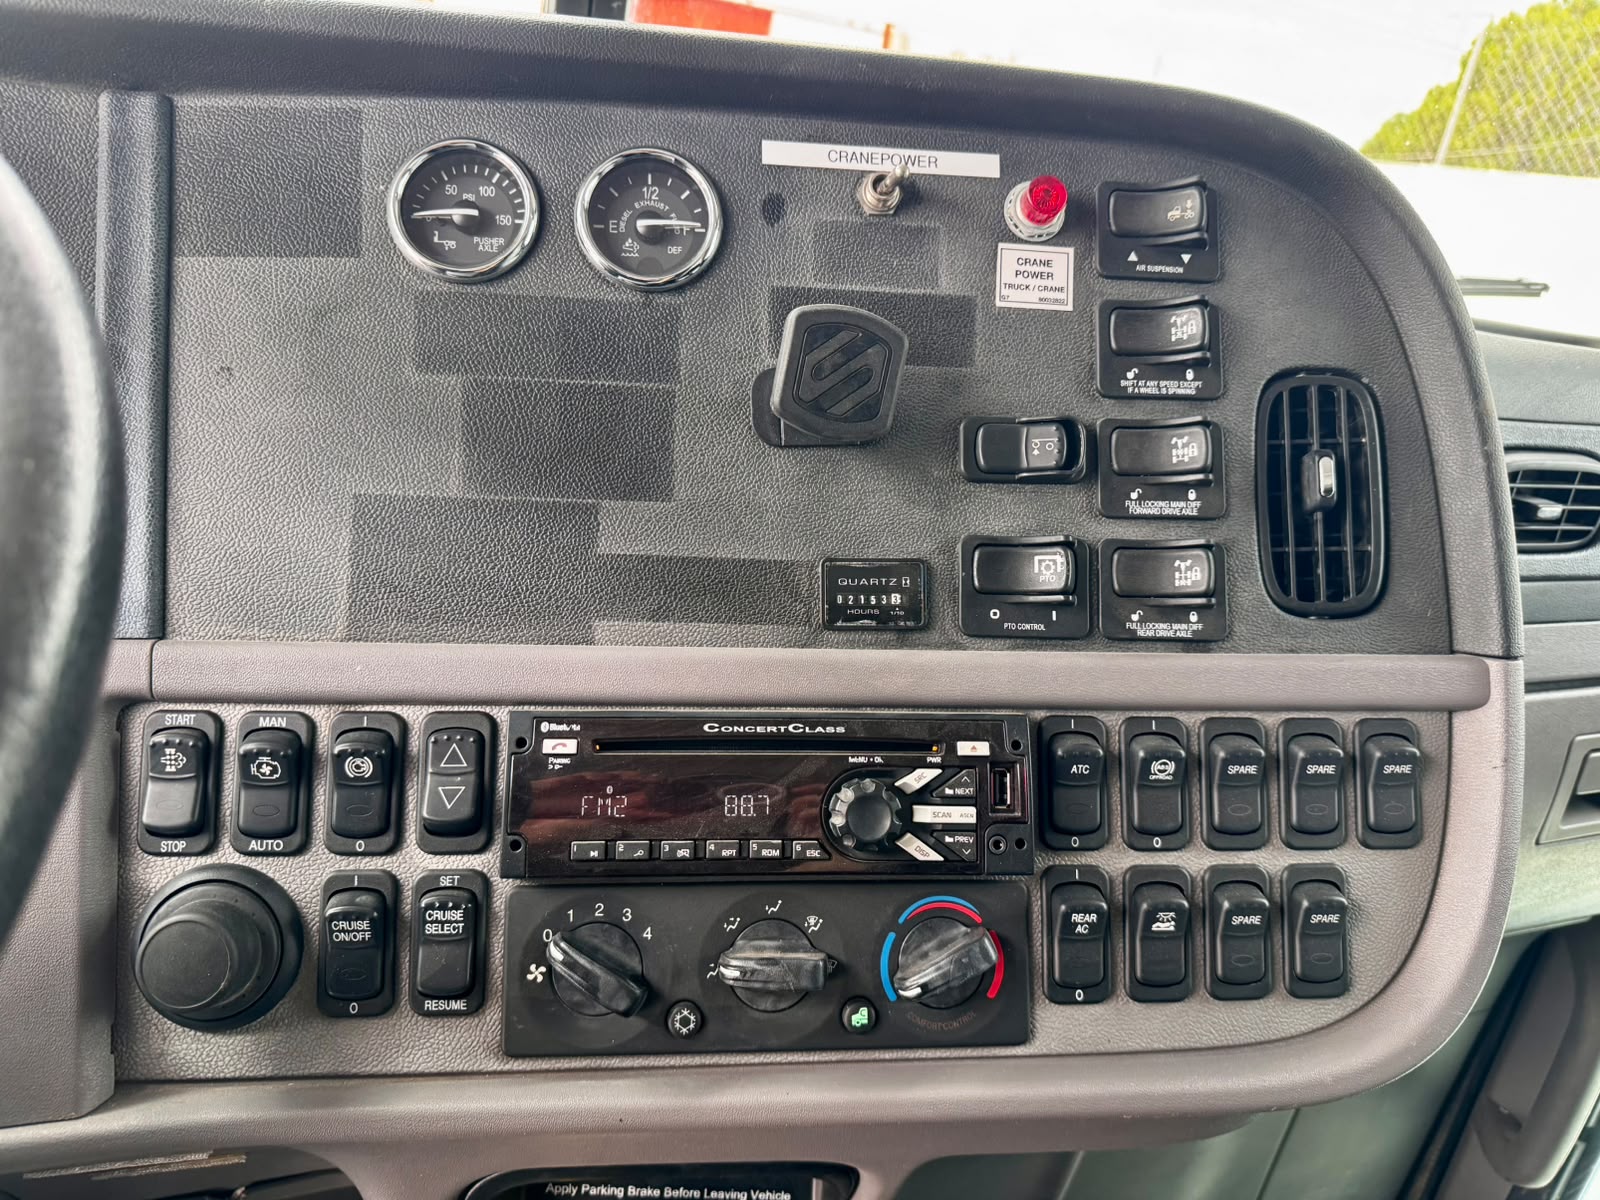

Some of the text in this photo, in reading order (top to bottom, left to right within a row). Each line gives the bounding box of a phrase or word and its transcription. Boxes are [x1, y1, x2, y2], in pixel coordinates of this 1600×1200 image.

[827, 149, 939, 169] CRANEPOWER
[444, 184, 458, 195] 50
[478, 186, 496, 197] 100
[642, 186, 659, 200] 1/2
[462, 193, 476, 202] PSI
[495, 214, 512, 226] 150
[619, 209, 633, 233] DIESEL
[633, 200, 670, 212] EXHAUST
[609, 220, 618, 233] E
[473, 236, 505, 246] PUSHER
[478, 244, 499, 253] AXLE
[667, 246, 683, 255] DEF
[1016, 257, 1054, 268] CRANE
[1135, 264, 1184, 274] AIR SUSPENSION
[1015, 269, 1054, 281] POWER
[1003, 282, 1031, 292] TRUCK
[1037, 285, 1065, 294] CRANE
[1146, 380, 1159, 388] ANY
[1159, 380, 1179, 389] SPEED
[1179, 381, 1203, 389] EXCEPT
[1139, 387, 1160, 395] WHEEL
[1160, 387, 1167, 395] IS
[1167, 388, 1196, 396] SPINNING
[1125, 500, 1140, 508] FULL
[1141, 500, 1170, 508] LOCKING
[1187, 501, 1202, 509] DIFF
[1129, 507, 1199, 516] FORWARD DRIVE AXLE
[838, 577, 898, 586] QUARTZ
[1039, 575, 1056, 583] PTO
[1003, 622, 1046, 631] PTO CONTROL
[1126, 622, 1141, 630] FULL
[1142, 622, 1171, 630] LOCKING
[1188, 623, 1204, 631] DIFF
[1137, 629, 1194, 638] REAR DRIVE AXLE
[165, 714, 196, 726] START
[259, 717, 287, 728] MAN
[1070, 764, 1090, 774] ATC
[1227, 763, 1258, 775] SPARE
[1305, 763, 1336, 775] SPARE
[1383, 763, 1413, 775] SPARE
[725, 795, 769, 816] 88.7
[932, 811, 952, 819] SCAN
[160, 841, 187, 853] STOP
[249, 841, 284, 852] AUTO
[914, 845, 930, 858] DISP
[721, 849, 736, 857] RPT
[761, 849, 780, 857] RDM
[439, 875, 460, 886] SET
[425, 910, 464, 921] CRUISE
[567, 909, 574, 922] 1
[594, 903, 604, 917] 2
[622, 908, 632, 922] 3
[1071, 913, 1097, 923] REAR
[1231, 915, 1261, 926] SPARE
[1310, 914, 1340, 924] SPARE
[331, 920, 371, 930] CRUISE
[424, 923, 464, 934] SELECT
[1075, 925, 1089, 934] AC
[332, 932, 372, 942] ON/OFF
[642, 927, 652, 940] 4
[424, 1000, 467, 1011] RESUME
[545, 1182, 791, 1200] Apply Parking Brake Before Leaving Vehicle
